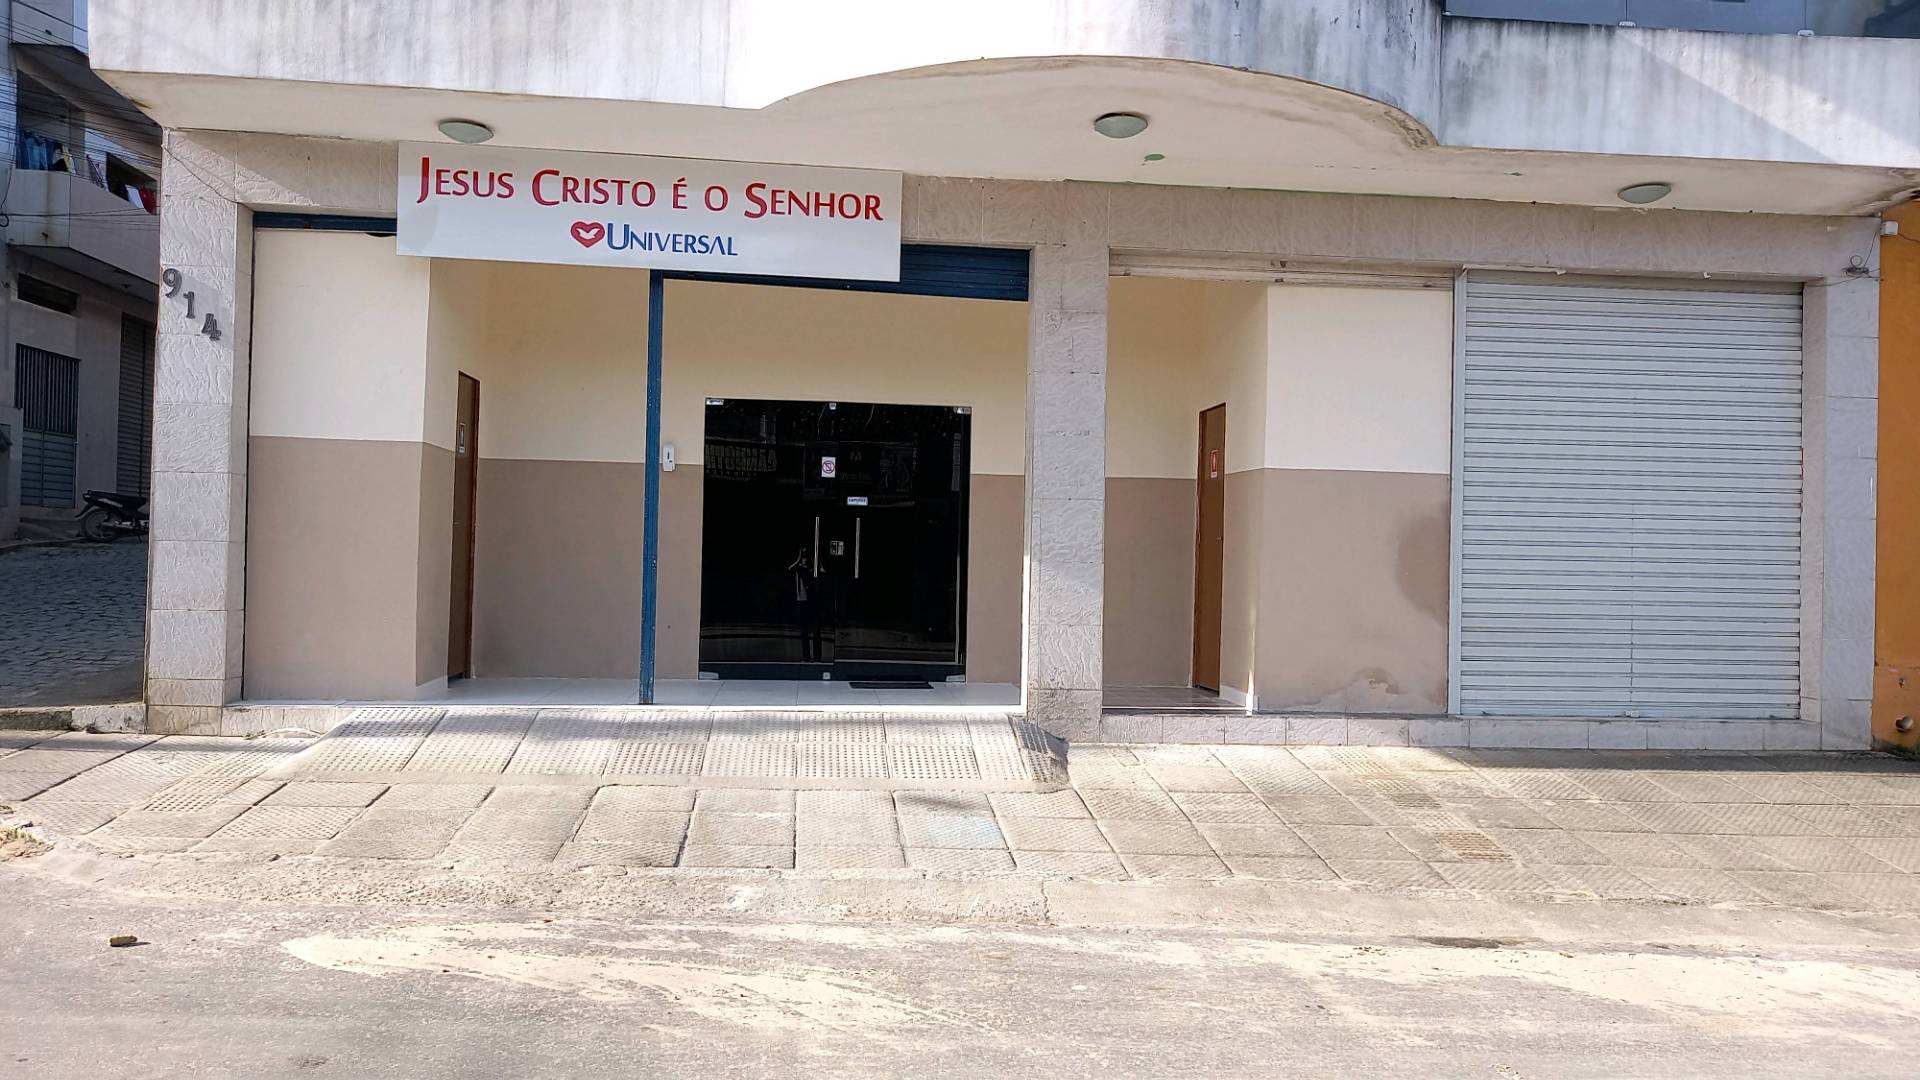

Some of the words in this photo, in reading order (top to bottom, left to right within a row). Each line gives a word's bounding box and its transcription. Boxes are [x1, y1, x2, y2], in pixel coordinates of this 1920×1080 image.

[416, 156, 514, 204] JESUS
[531, 169, 656, 209] CRISTO
[672, 177, 687, 210] É
[704, 185, 729, 212] O
[744, 182, 884, 222] SENHOR
[606, 222, 739, 257] UNIVERSAL
